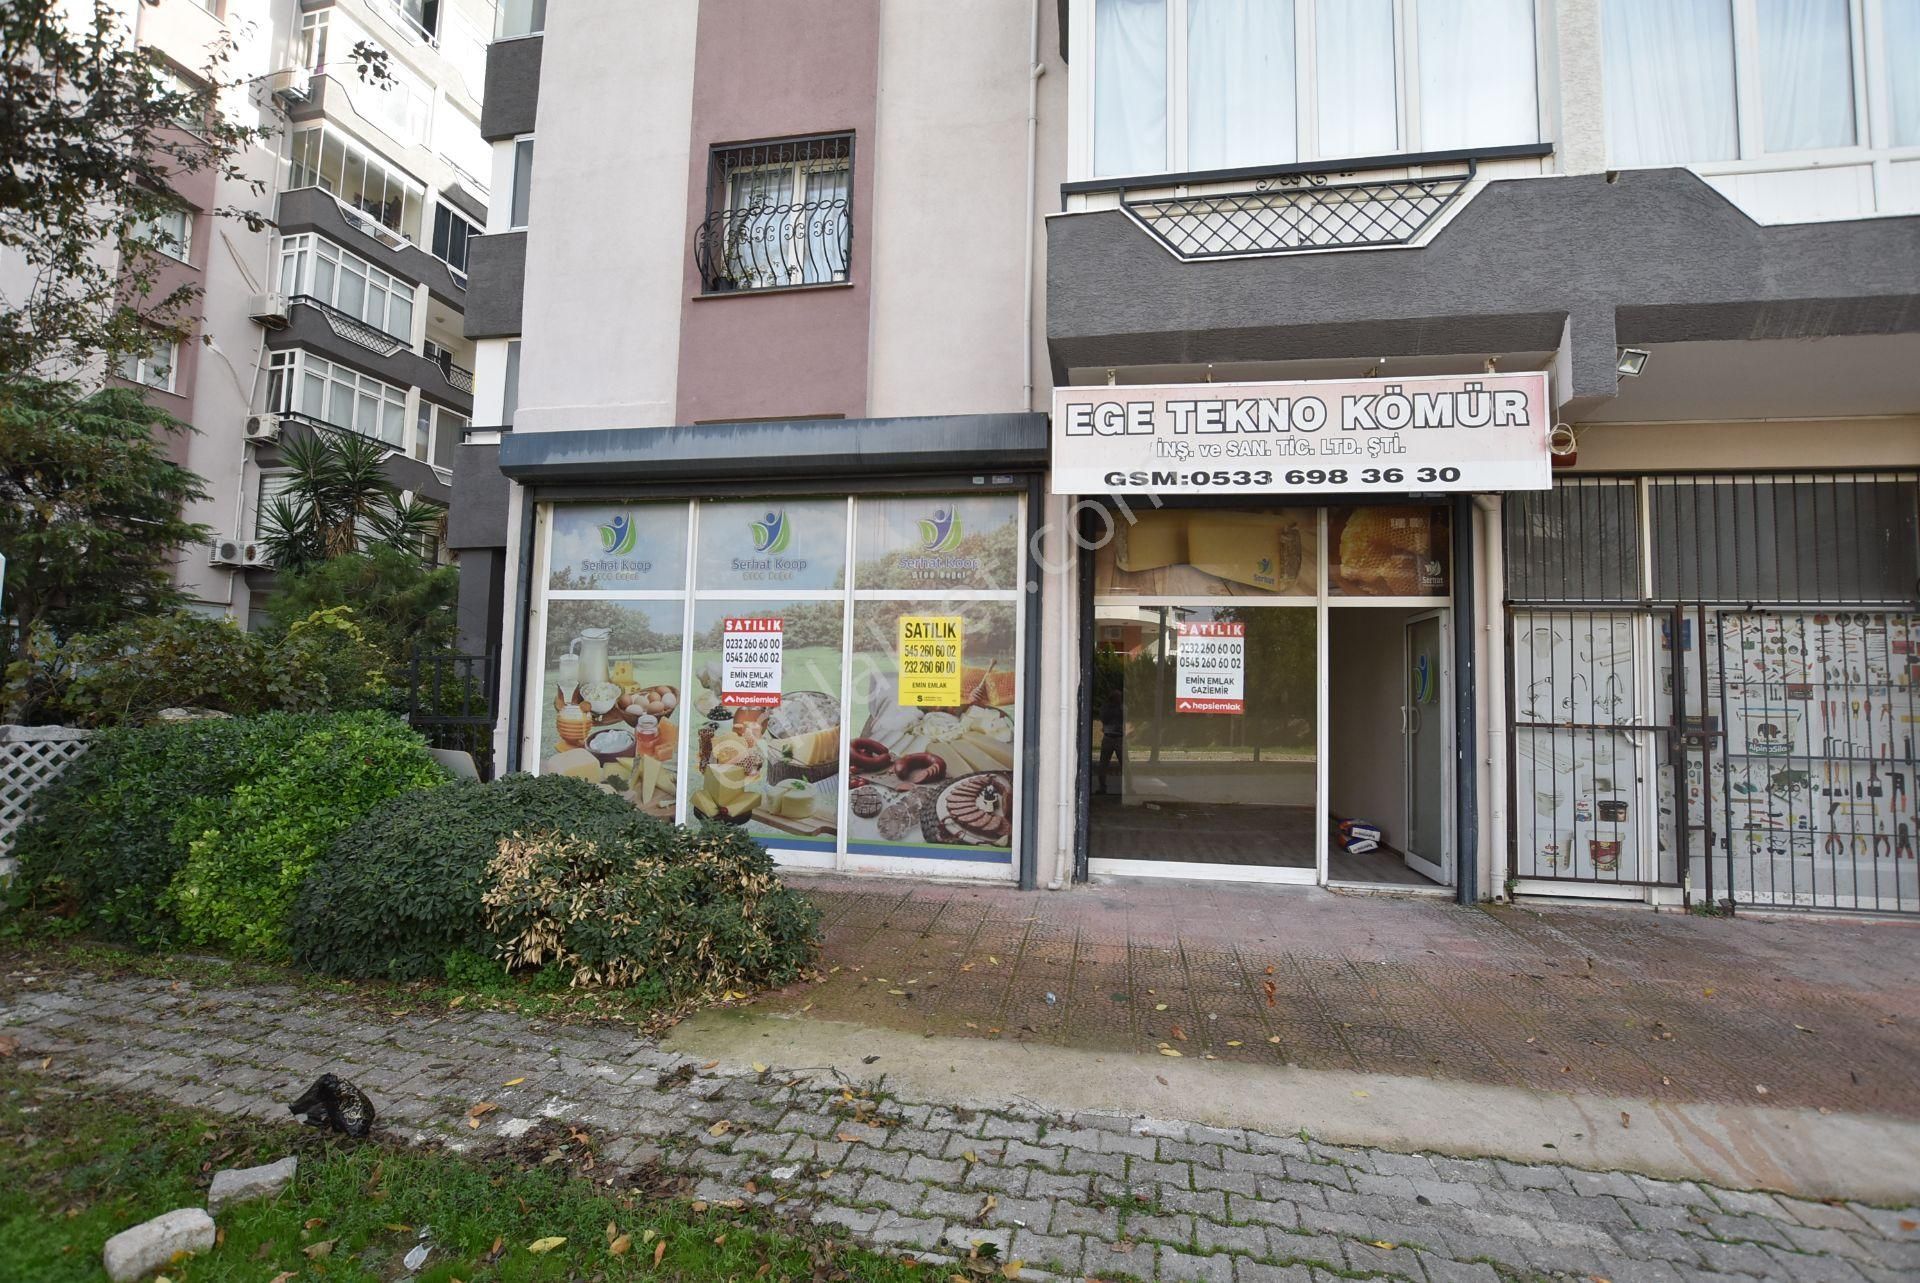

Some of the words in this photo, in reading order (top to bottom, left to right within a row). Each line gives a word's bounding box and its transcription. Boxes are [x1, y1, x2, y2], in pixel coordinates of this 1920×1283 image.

[1066, 401, 1155, 437] EGE
[1166, 396, 1327, 435] TEKNO
[1341, 382, 1530, 431] KÖMÜR
[1157, 438, 1194, 461] İNŞ.
[1199, 444, 1221, 457] ve
[1226, 440, 1271, 457] SAN.
[1276, 435, 1316, 456] TİC.
[1321, 438, 1362, 456] LTD.
[1367, 432, 1406, 458] ŞTİ.
[1104, 470, 1272, 486] GSM:0533
[1285, 468, 1348, 485] 698
[1361, 468, 1404, 484] 36
[1416, 467, 1461, 483] 30
[582, 559, 617, 571] Serhat
[621, 560, 652, 573] Koop
[731, 558, 770, 570] Serhat
[774, 559, 807, 572] Koop
[898, 556, 941, 569] Serhat
[945, 557, 981, 570] Koop
[726, 620, 781, 631] SATILIK
[905, 622, 956, 638] SATILIK
[1179, 624, 1242, 635] SATILIK
[726, 639, 742, 649] 0232
[744, 639, 757, 649] 260
[759, 639, 768, 649] 60
[770, 639, 780, 649] 00
[1201, 643, 1215, 654] 260
[1217, 644, 1228, 654] 60
[1230, 644, 1241, 654] 00
[905, 645, 918, 657] 545
[920, 645, 934, 657] 260
[935, 645, 944, 657] 60
[947, 645, 956, 657] 02
[726, 653, 742, 662] 0545
[745, 653, 757, 662] 260
[760, 653, 768, 662] 60
[770, 653, 779, 662] 02
[1180, 657, 1199, 667] 0545
[1202, 658, 1216, 668] 260
[1219, 658, 1229, 668] 60
[1231, 658, 1241, 668] 02
[905, 661, 918, 673] 232
[920, 661, 933, 673] 260
[935, 661, 944, 673] 60
[946, 661, 956, 673] 00
[730, 670, 747, 678] EMİN
[1186, 675, 1205, 684] EMİN
[1207, 677, 1234, 685] EMLAK
[736, 695, 779, 704] hepsiemlak
[1193, 702, 1240, 710] hepsiemlak
